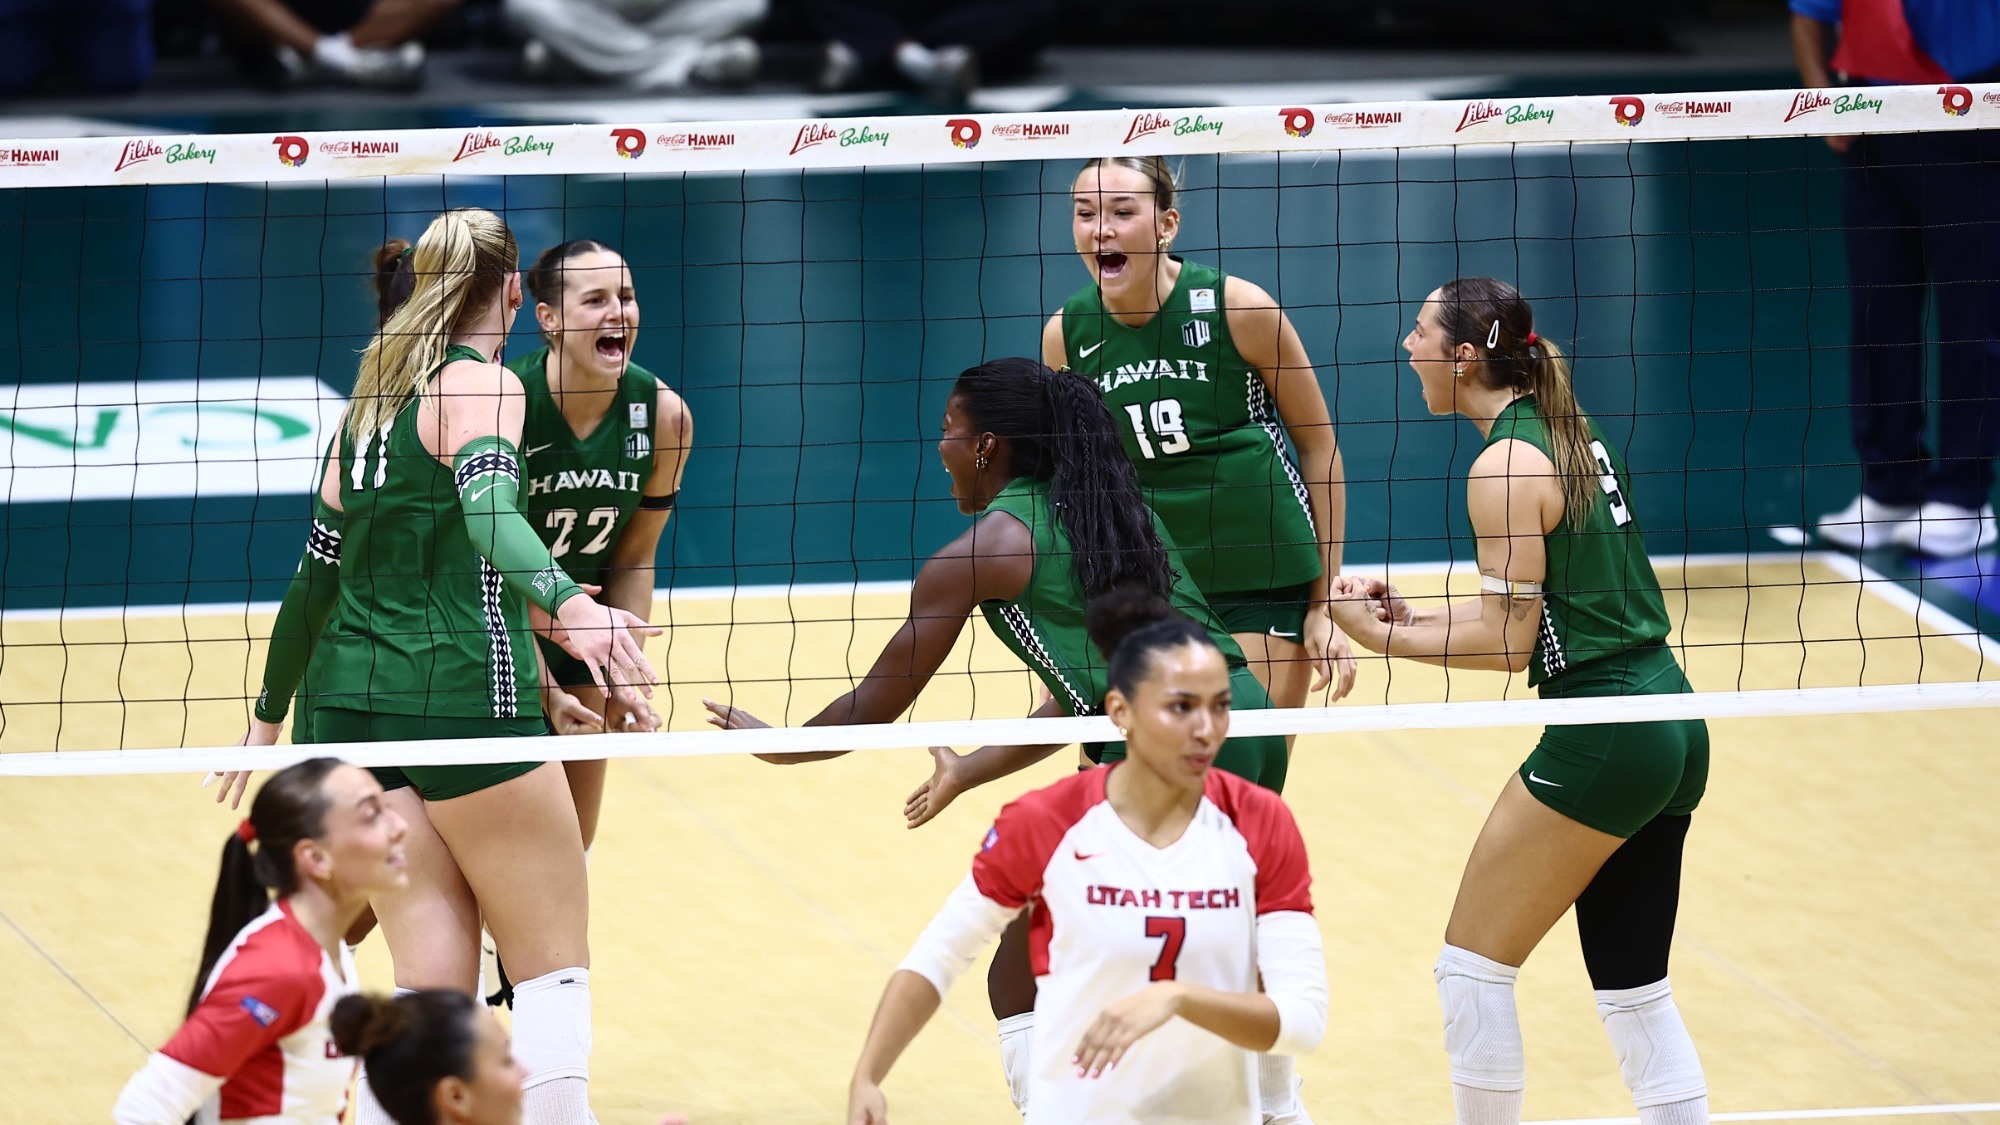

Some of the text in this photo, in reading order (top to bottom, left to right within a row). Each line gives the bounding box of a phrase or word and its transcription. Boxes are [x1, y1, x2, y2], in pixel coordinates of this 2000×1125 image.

[1355, 112, 1402, 125] HAWAII
[1455, 101, 1554, 133] Liliha Bakery
[1685, 101, 1731, 114] HAWAII
[1784, 91, 1883, 122] Liliha Bakery
[688, 134, 735, 146] HAWAII
[789, 123, 889, 156] Liliha Bakery
[1022, 123, 1069, 136] HAWAII
[1123, 112, 1223, 144] Liliha Bakery
[12, 150, 59, 162] HAWAII
[114, 139, 216, 172] Liliha Bakery
[351, 141, 399, 154] HAWAII
[452, 131, 554, 162] Liliha Bakery
[1123, 398, 1191, 460] 19
[545, 506, 619, 558] 22
[1087, 885, 1240, 909] UTAH TECH
[1145, 916, 1186, 981] 7
